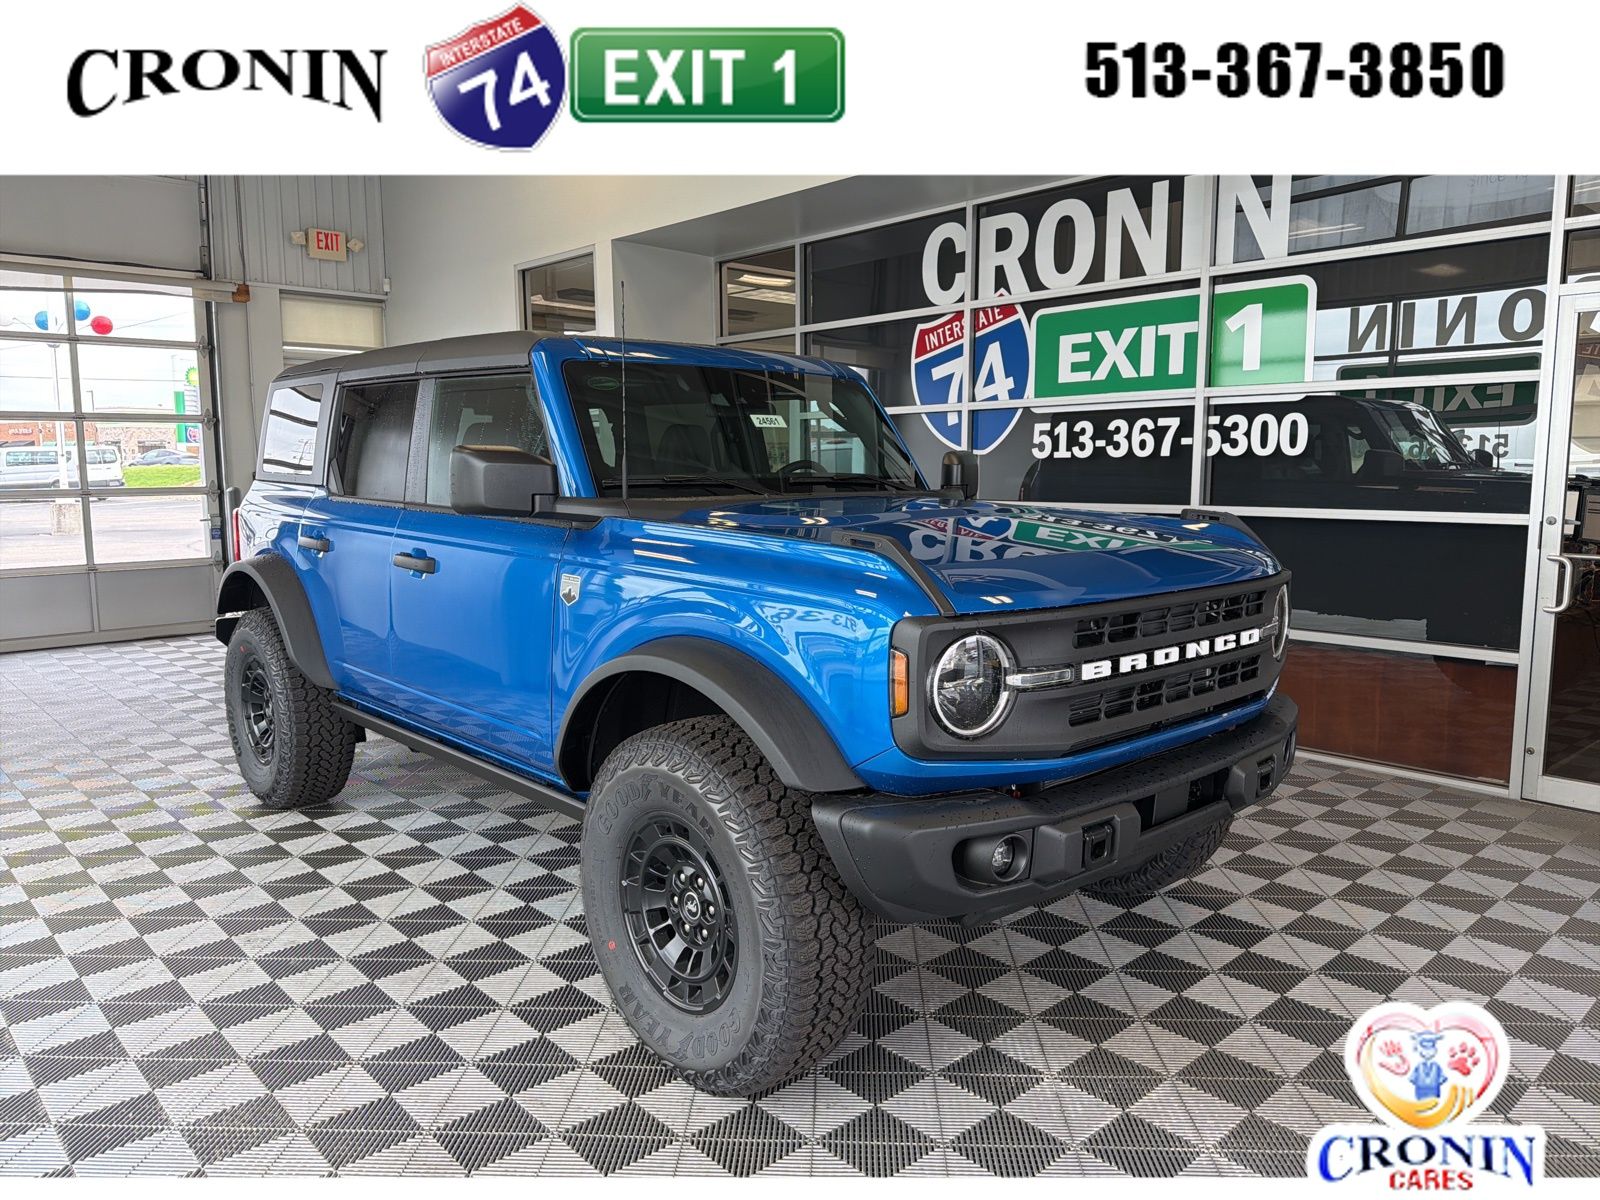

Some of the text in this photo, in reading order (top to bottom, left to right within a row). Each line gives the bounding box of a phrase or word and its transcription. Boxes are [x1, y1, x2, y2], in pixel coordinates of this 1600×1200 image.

[315, 231, 342, 253] EXIT
[921, 174, 1293, 307] CRONIN
[924, 306, 1004, 352] INTERATE
[1058, 303, 1263, 384] EXIT 1
[930, 340, 1015, 427] 74
[1031, 412, 1309, 460] 513-367-5300
[1081, 628, 1261, 681] BRONCO
